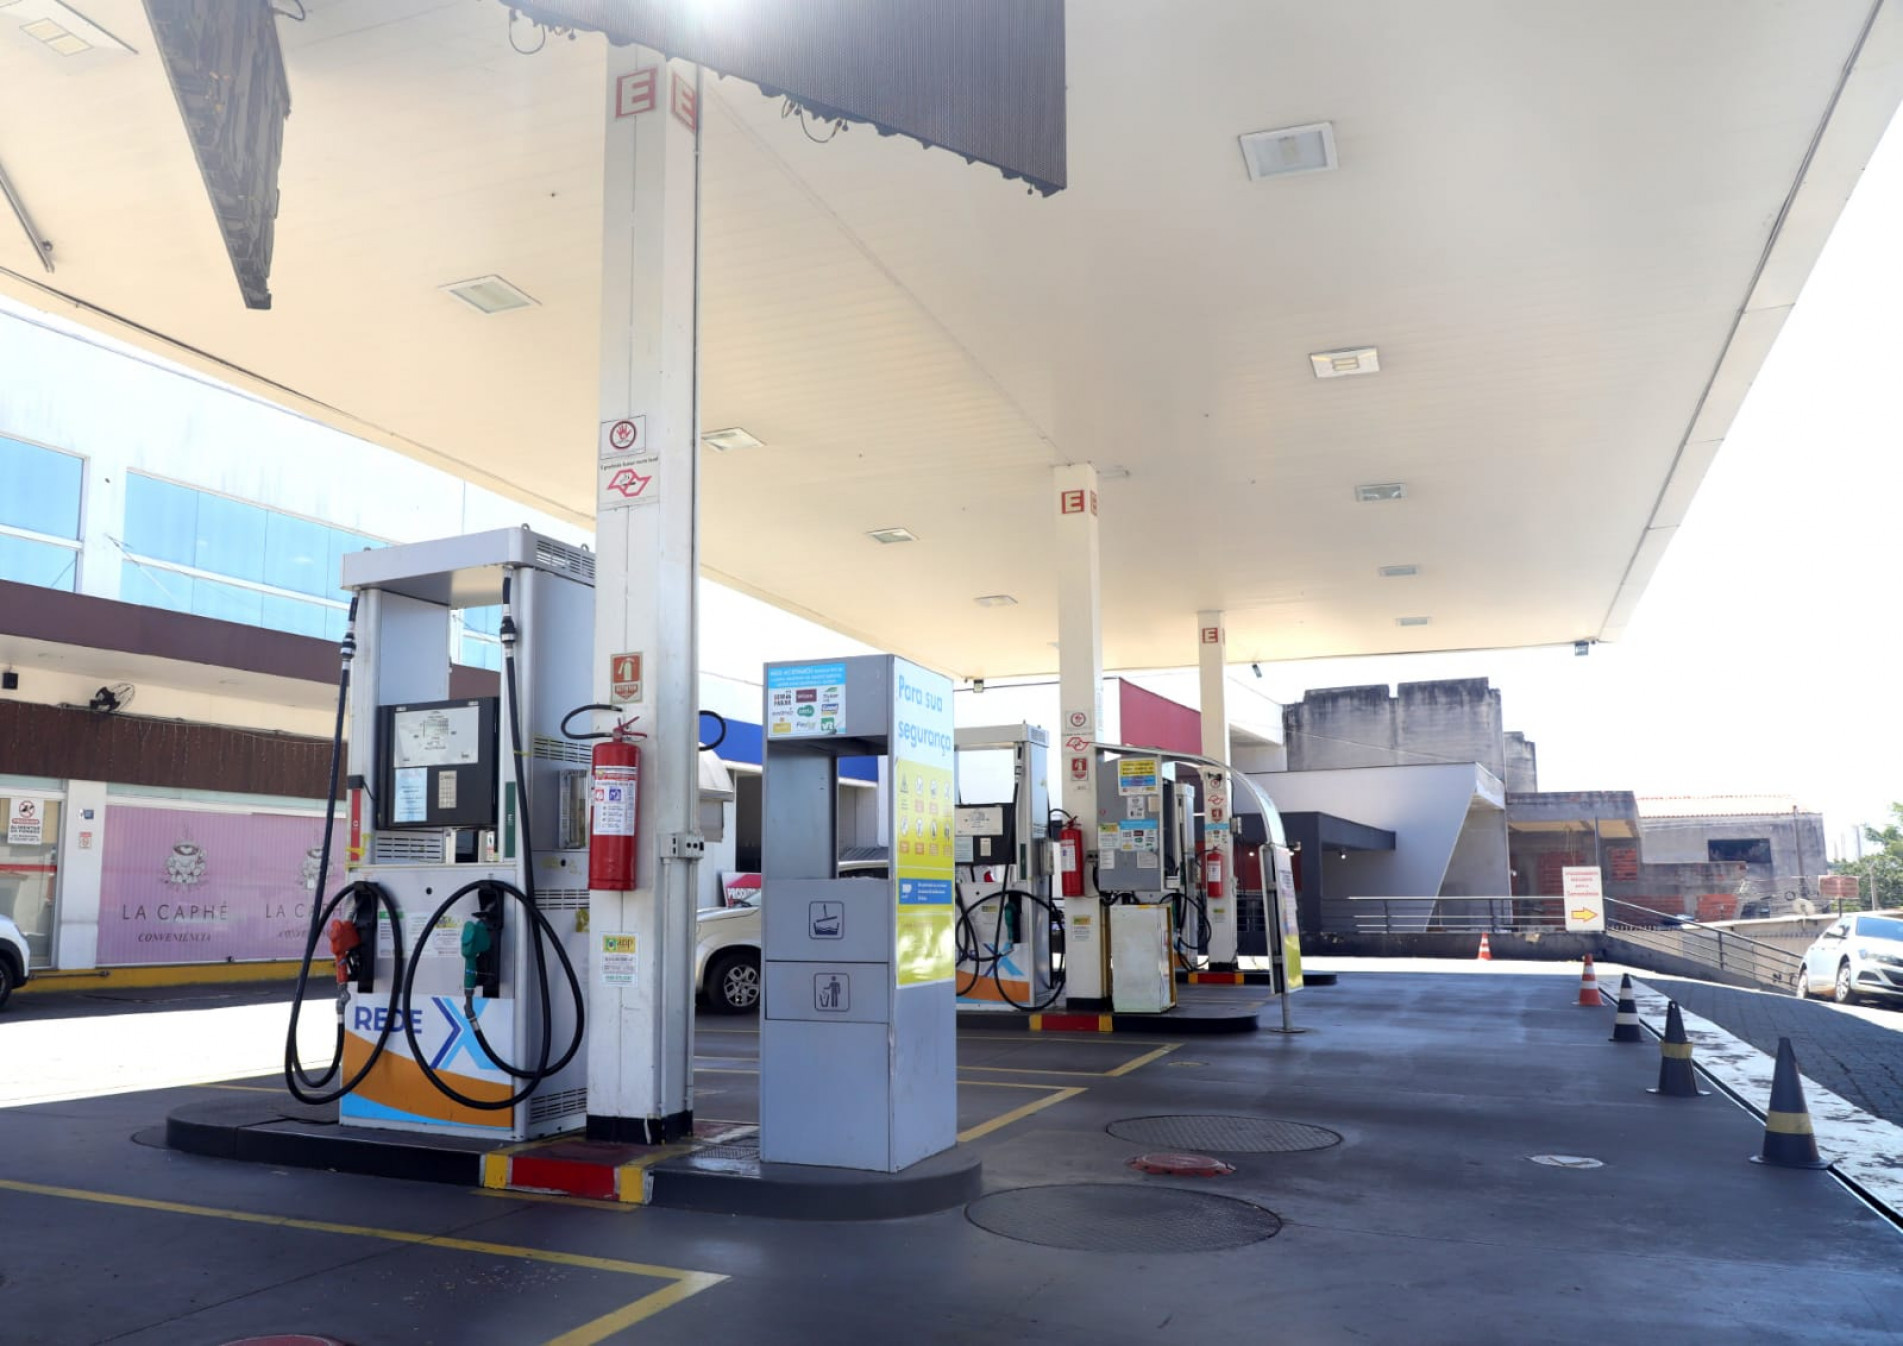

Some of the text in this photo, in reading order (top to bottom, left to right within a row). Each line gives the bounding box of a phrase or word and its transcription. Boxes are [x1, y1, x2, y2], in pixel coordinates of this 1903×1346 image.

[618, 70, 652, 116] E
[1063, 491, 1082, 513] E
[1203, 628, 1217, 643] E
[898, 675, 942, 712] Para sua
[898, 720, 951, 756] segurança
[123, 901, 227, 920] LA CAPHÉ
[266, 904, 286, 919] LA
